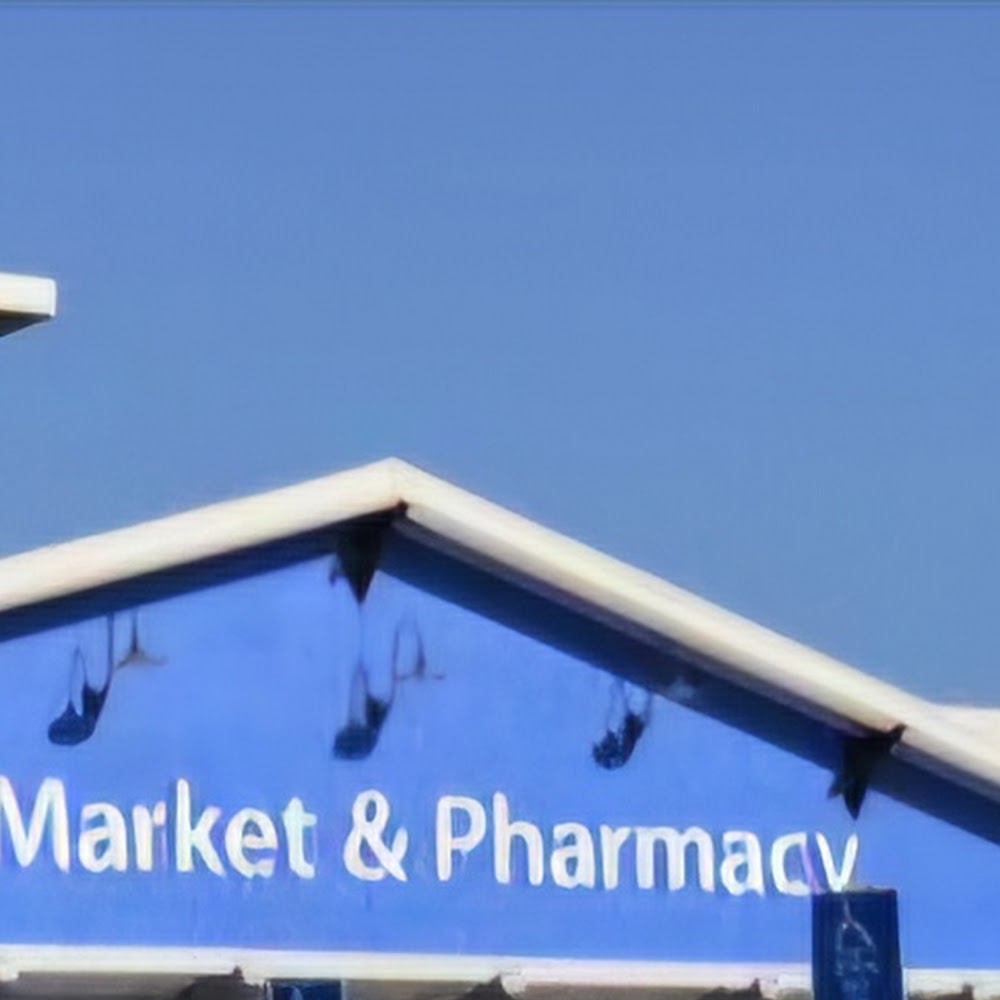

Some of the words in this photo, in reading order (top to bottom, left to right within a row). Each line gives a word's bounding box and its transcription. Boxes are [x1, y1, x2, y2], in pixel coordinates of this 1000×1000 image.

[0, 776, 317, 880] Market
[343, 789, 408, 883] &
[435, 792, 860, 896] Pharmacy
